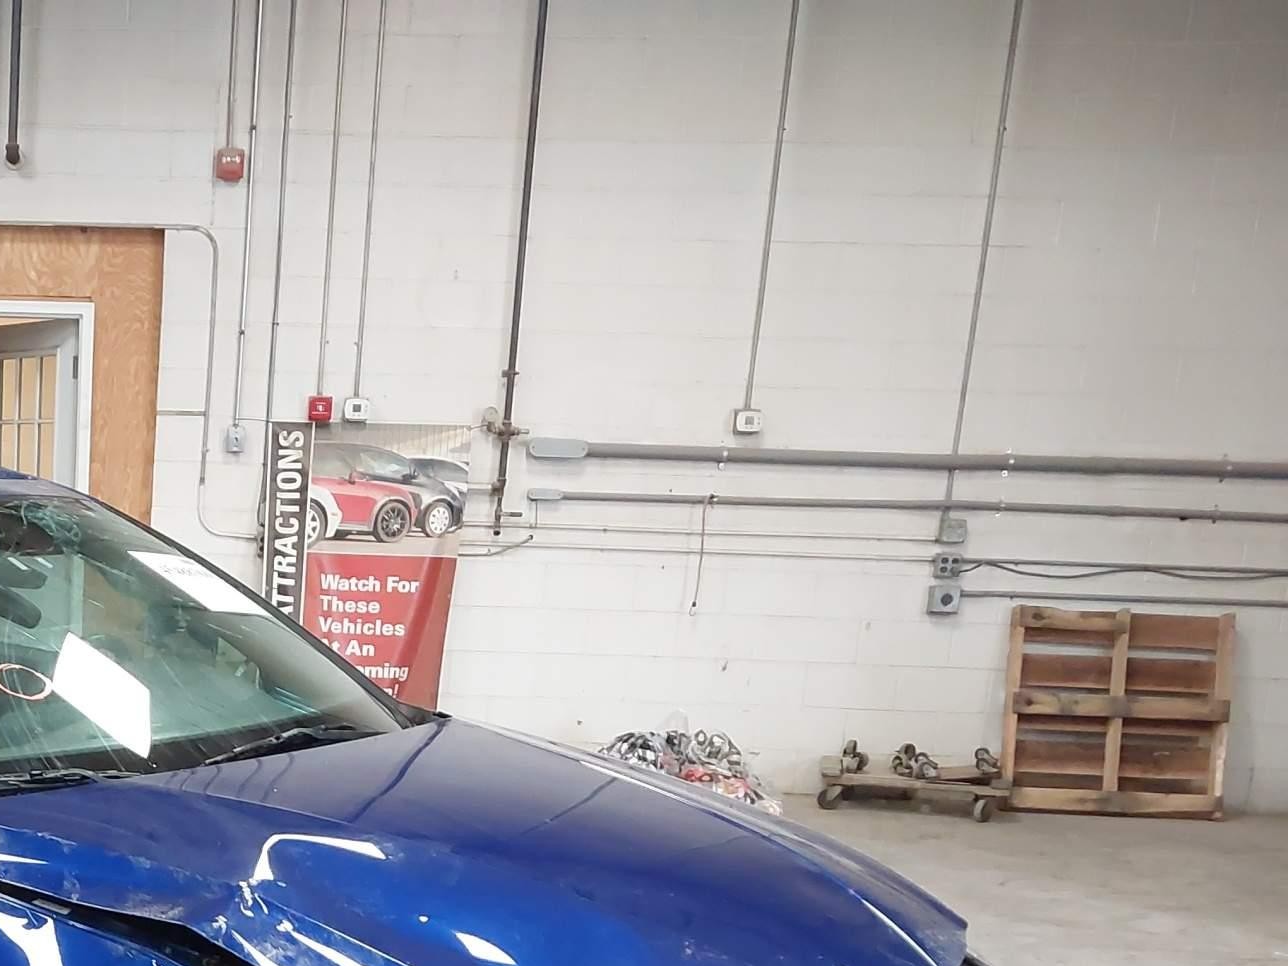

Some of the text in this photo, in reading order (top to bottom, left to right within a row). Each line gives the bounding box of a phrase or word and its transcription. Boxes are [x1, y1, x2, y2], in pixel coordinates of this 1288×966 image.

[320, 573, 420, 593] Watch For
[319, 594, 381, 613] These
[318, 616, 406, 636] Vehicles
[345, 639, 375, 657] An
